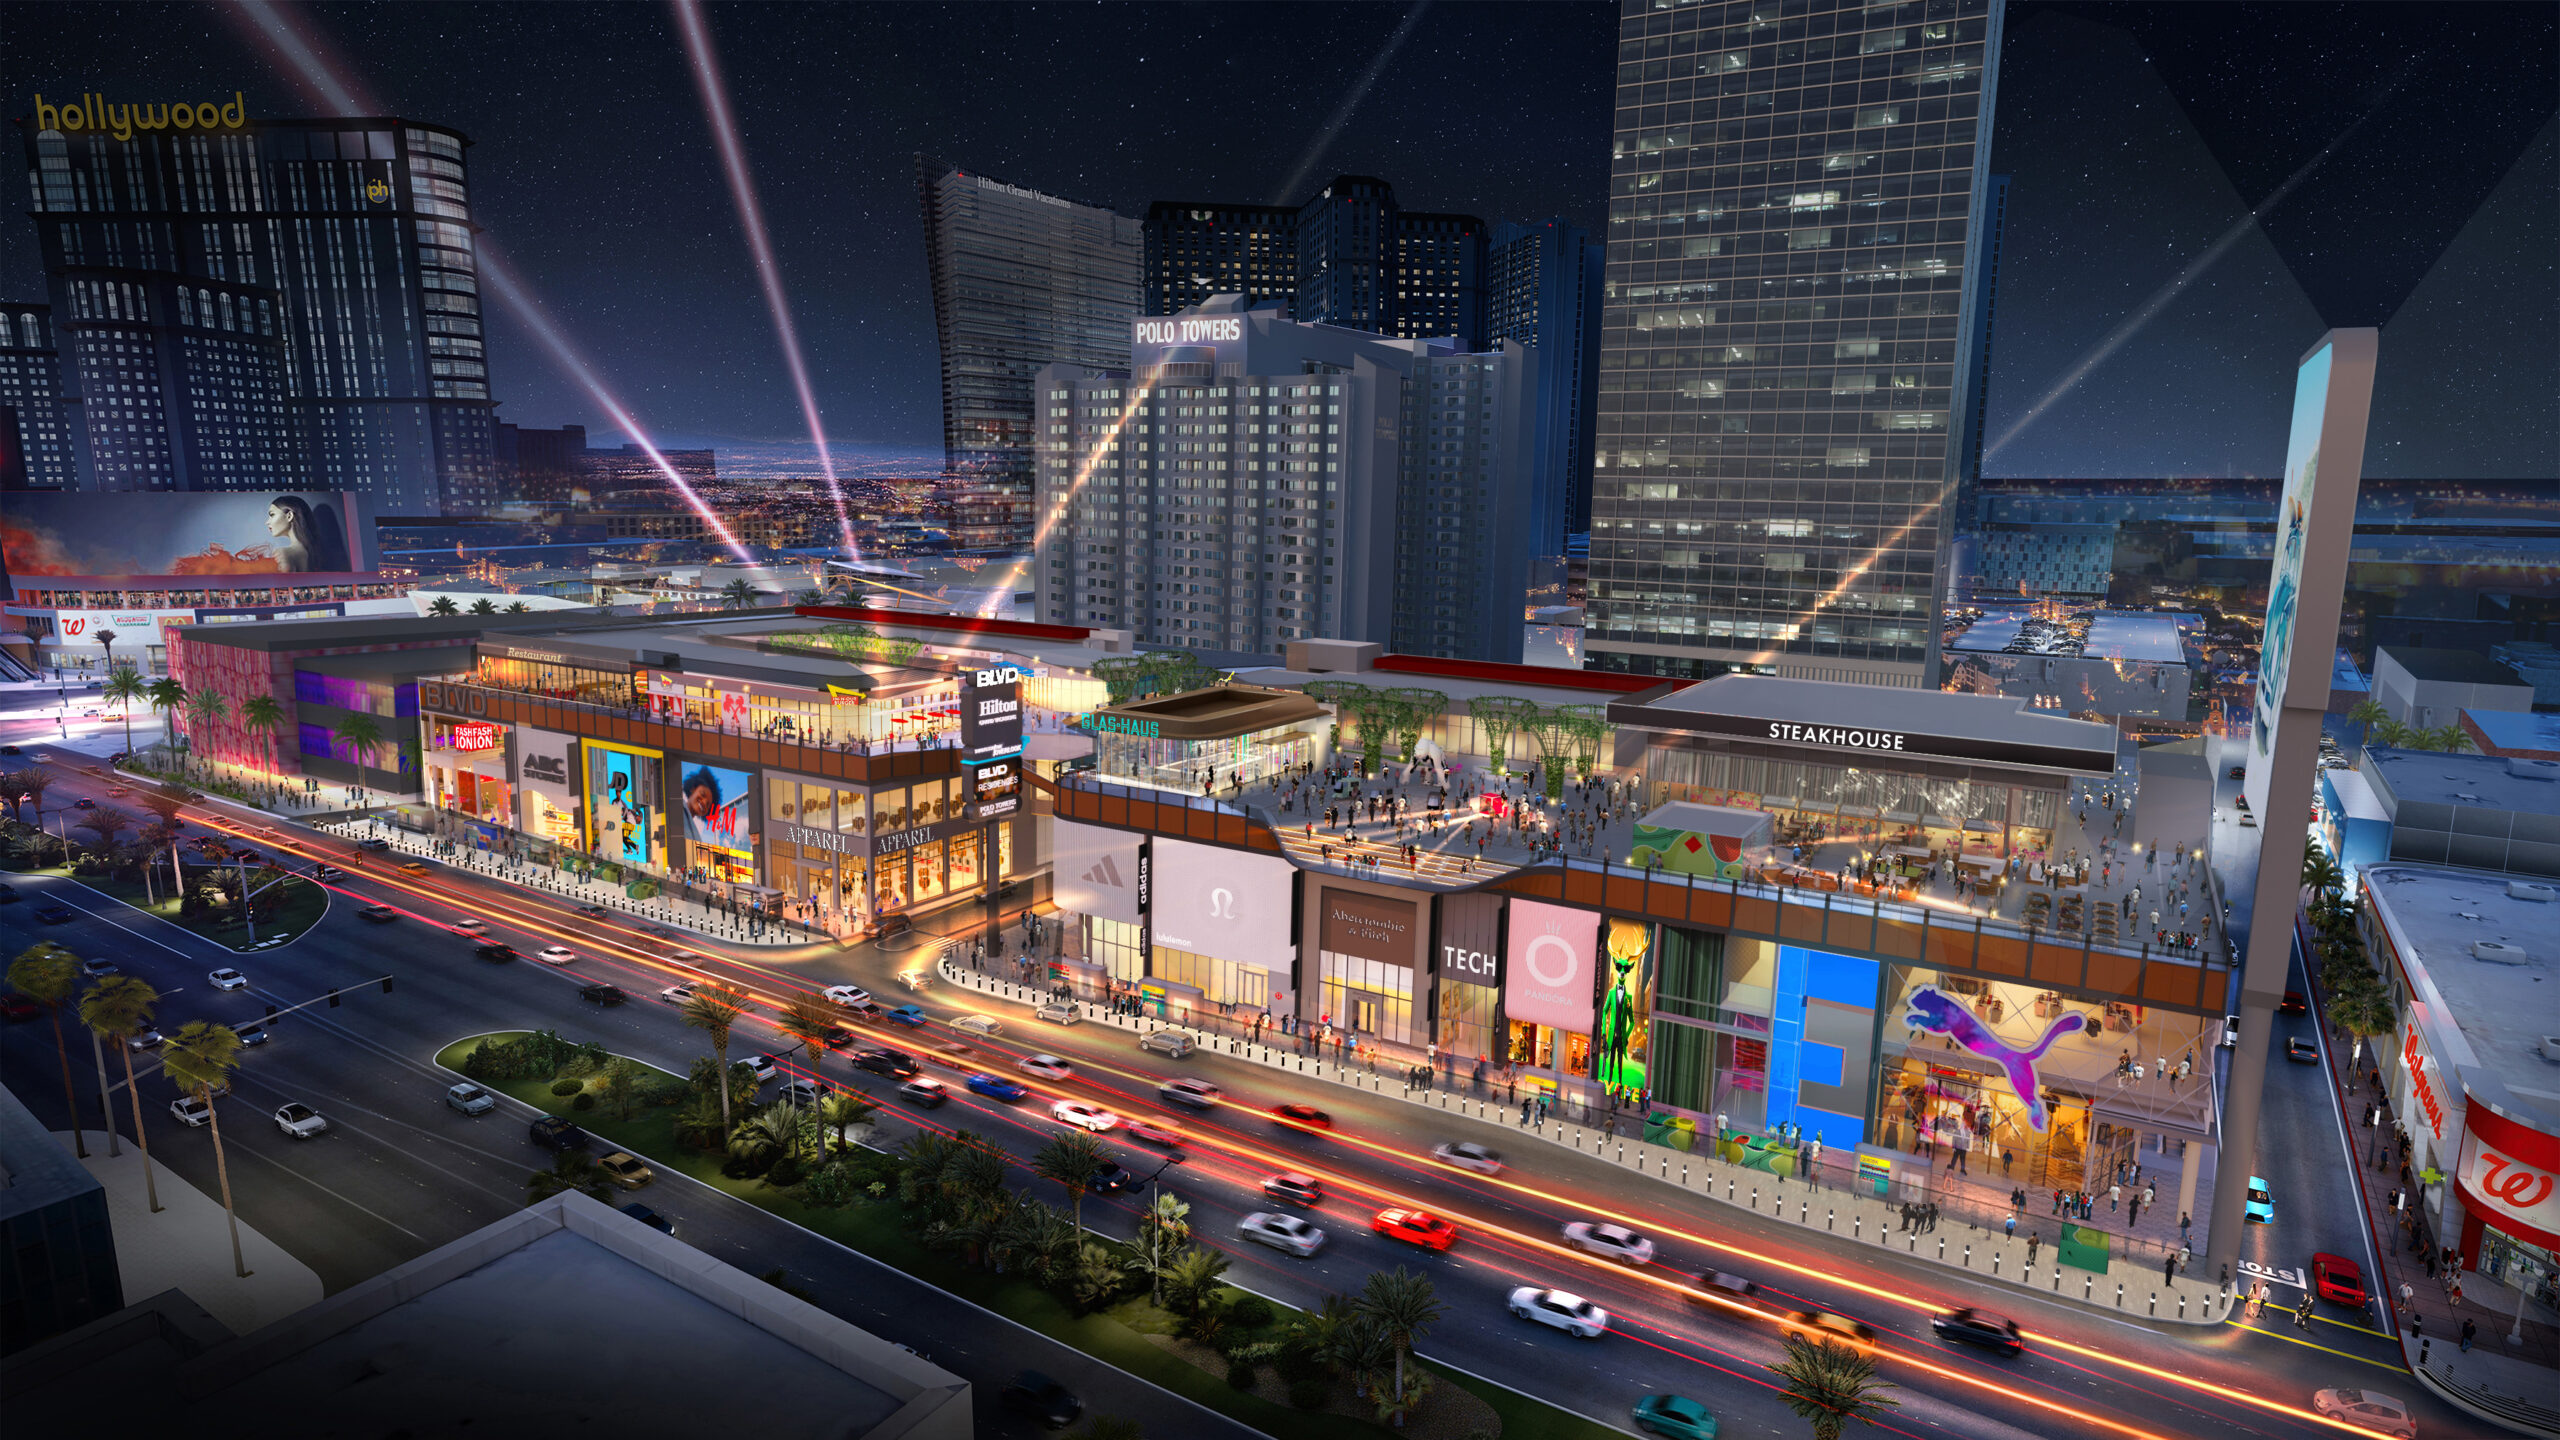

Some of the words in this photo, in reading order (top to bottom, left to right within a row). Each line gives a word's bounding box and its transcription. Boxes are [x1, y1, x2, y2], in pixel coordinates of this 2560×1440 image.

[35, 91, 245, 141] hollywood
[977, 176, 1005, 192] Hilton
[1007, 183, 1033, 199] Grand
[1034, 190, 1071, 208] Vacations
[1136, 321, 1175, 343] POLO
[1181, 318, 1241, 341] TOWERS
[507, 647, 562, 663] Restaurant
[976, 667, 1019, 688] BLVD
[425, 681, 487, 717] BLVD
[979, 698, 1018, 717] Hilton
[1769, 723, 1904, 750] STEAKHOUSE
[608, 771, 629, 791] JD
[978, 764, 1008, 780] BLVD
[705, 803, 737, 837] H&M
[786, 825, 851, 854] APPAREL
[877, 826, 935, 854] APPAREL
[1140, 857, 1148, 904] adidas
[1156, 931, 1192, 948] lululemon
[1444, 945, 1497, 977] TECH
[1525, 988, 1574, 1007] PANDORA
[2404, 1023, 2443, 1140] Walgreens
